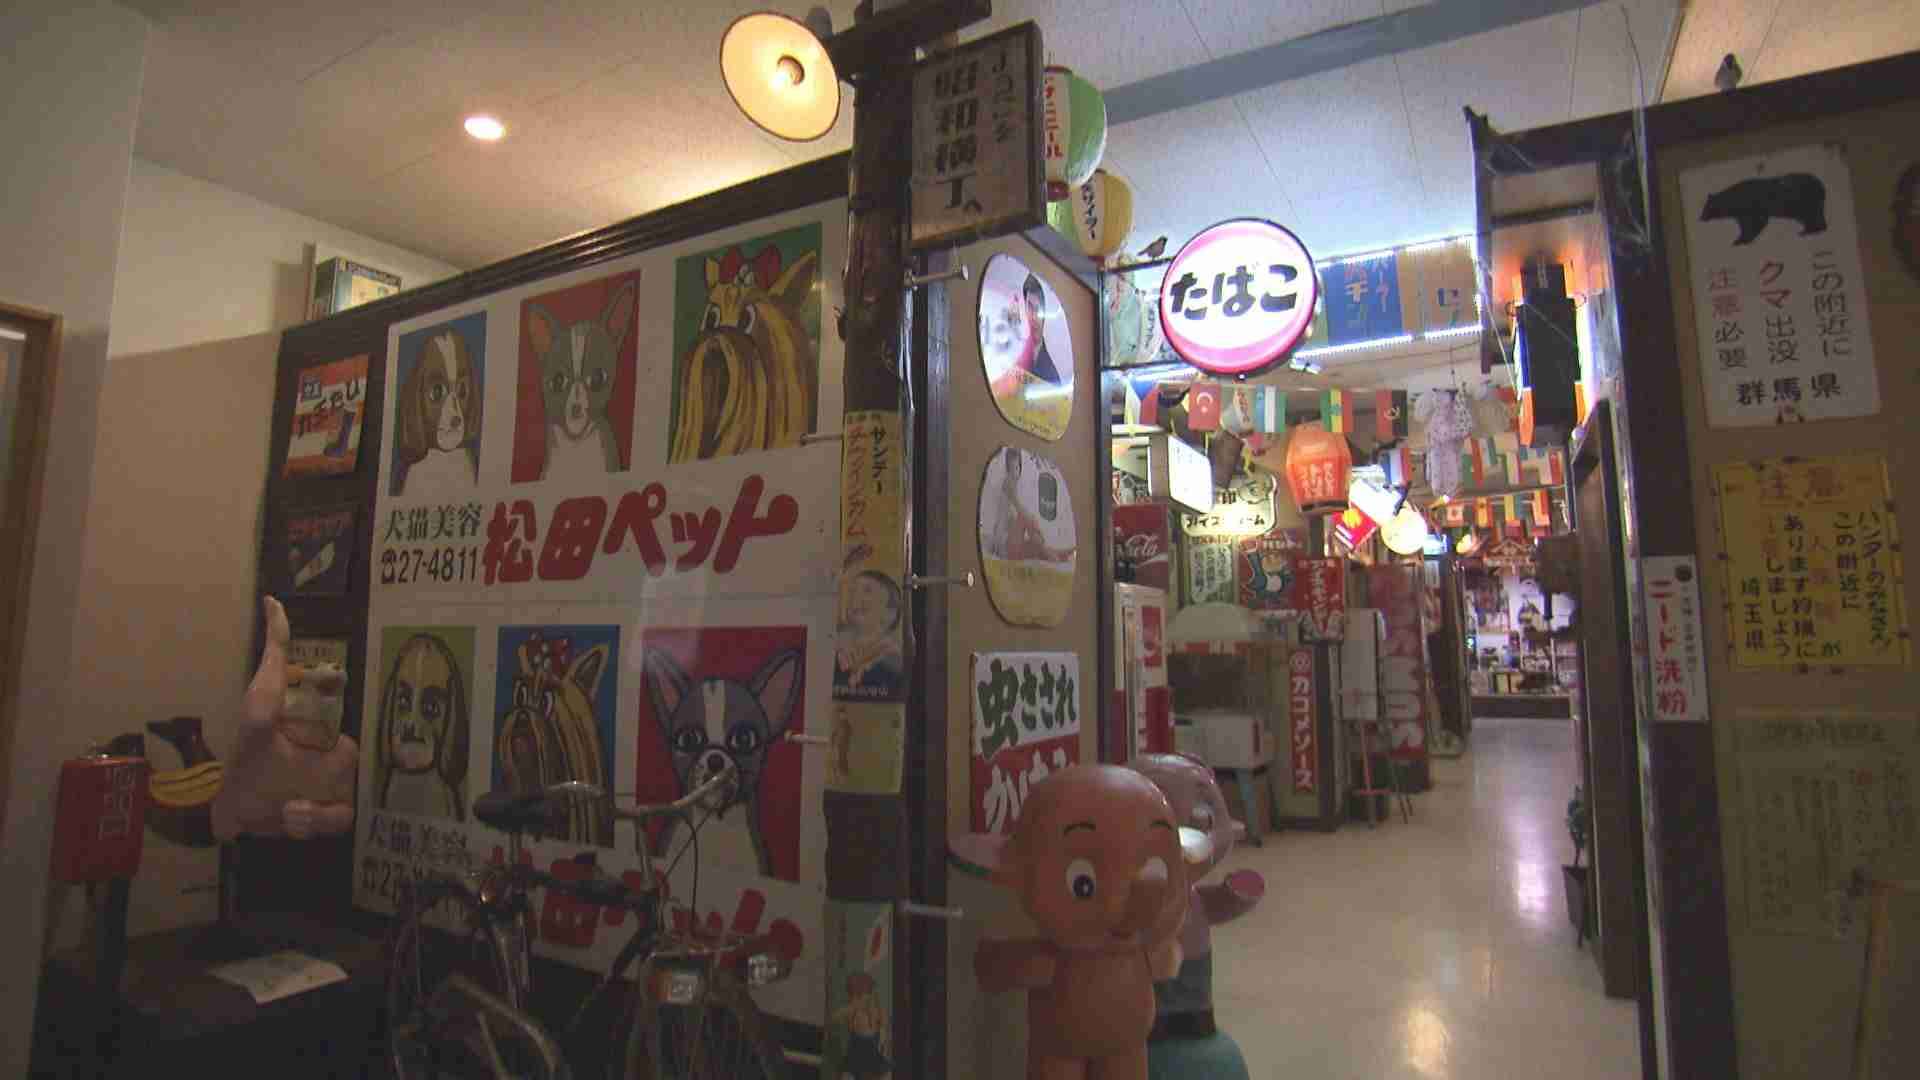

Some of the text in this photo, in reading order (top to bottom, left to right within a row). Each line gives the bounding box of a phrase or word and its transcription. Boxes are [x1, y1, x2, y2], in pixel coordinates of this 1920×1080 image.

[1169, 263, 1299, 320] たばこ
[1707, 267, 1748, 370] 注意必要
[1760, 260, 1801, 365] クマ出没
[1736, 373, 1841, 406] 群馬県
[384, 502, 482, 543] 犬猫美容
[398, 545, 478, 584] 27-4811
[483, 474, 799, 585] 松田ペット
[1649, 579, 1688, 716] ニード洗粉
[1742, 577, 1765, 650] 埼玉県
[978, 657, 1077, 762] 虫さされ
